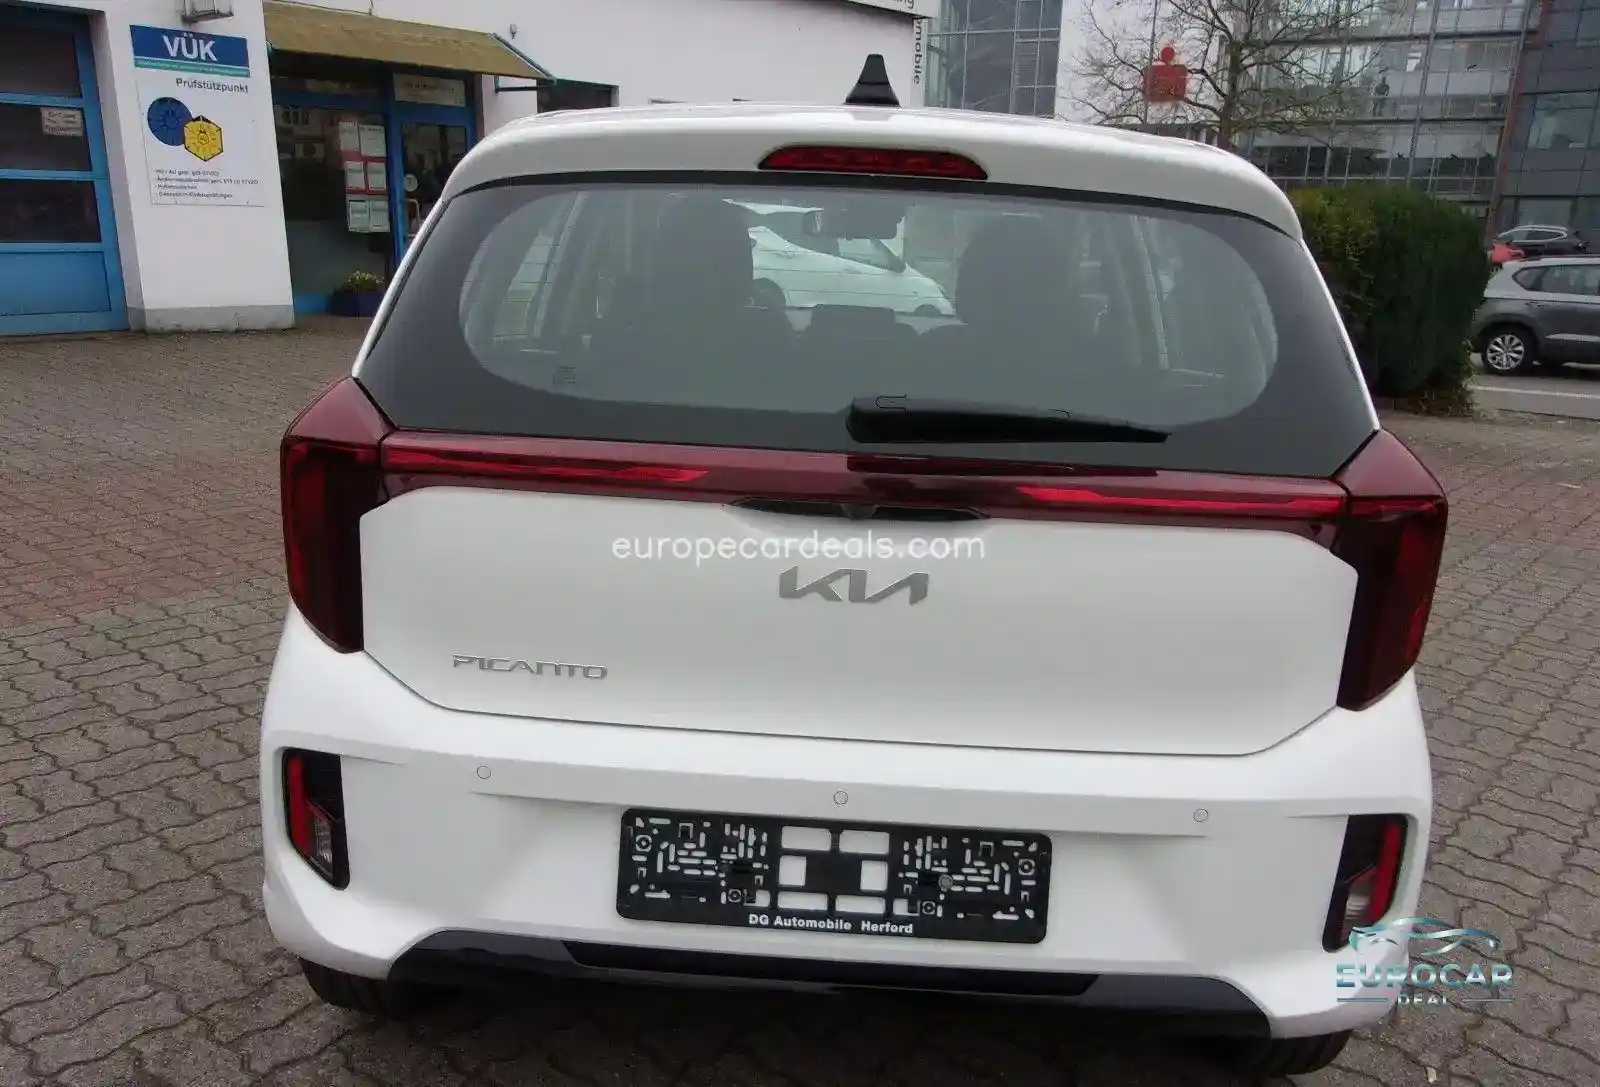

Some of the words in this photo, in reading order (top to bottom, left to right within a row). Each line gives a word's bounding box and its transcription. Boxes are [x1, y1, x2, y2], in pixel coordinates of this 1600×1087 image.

[163, 33, 217, 61] VÜK
[175, 77, 249, 93] Prüfstützpunkt
[779, 565, 929, 606] KIA
[453, 653, 609, 680] PICANTO
[748, 913, 769, 926] DG
[774, 915, 852, 931] Automobile
[861, 920, 913, 934] Herford
